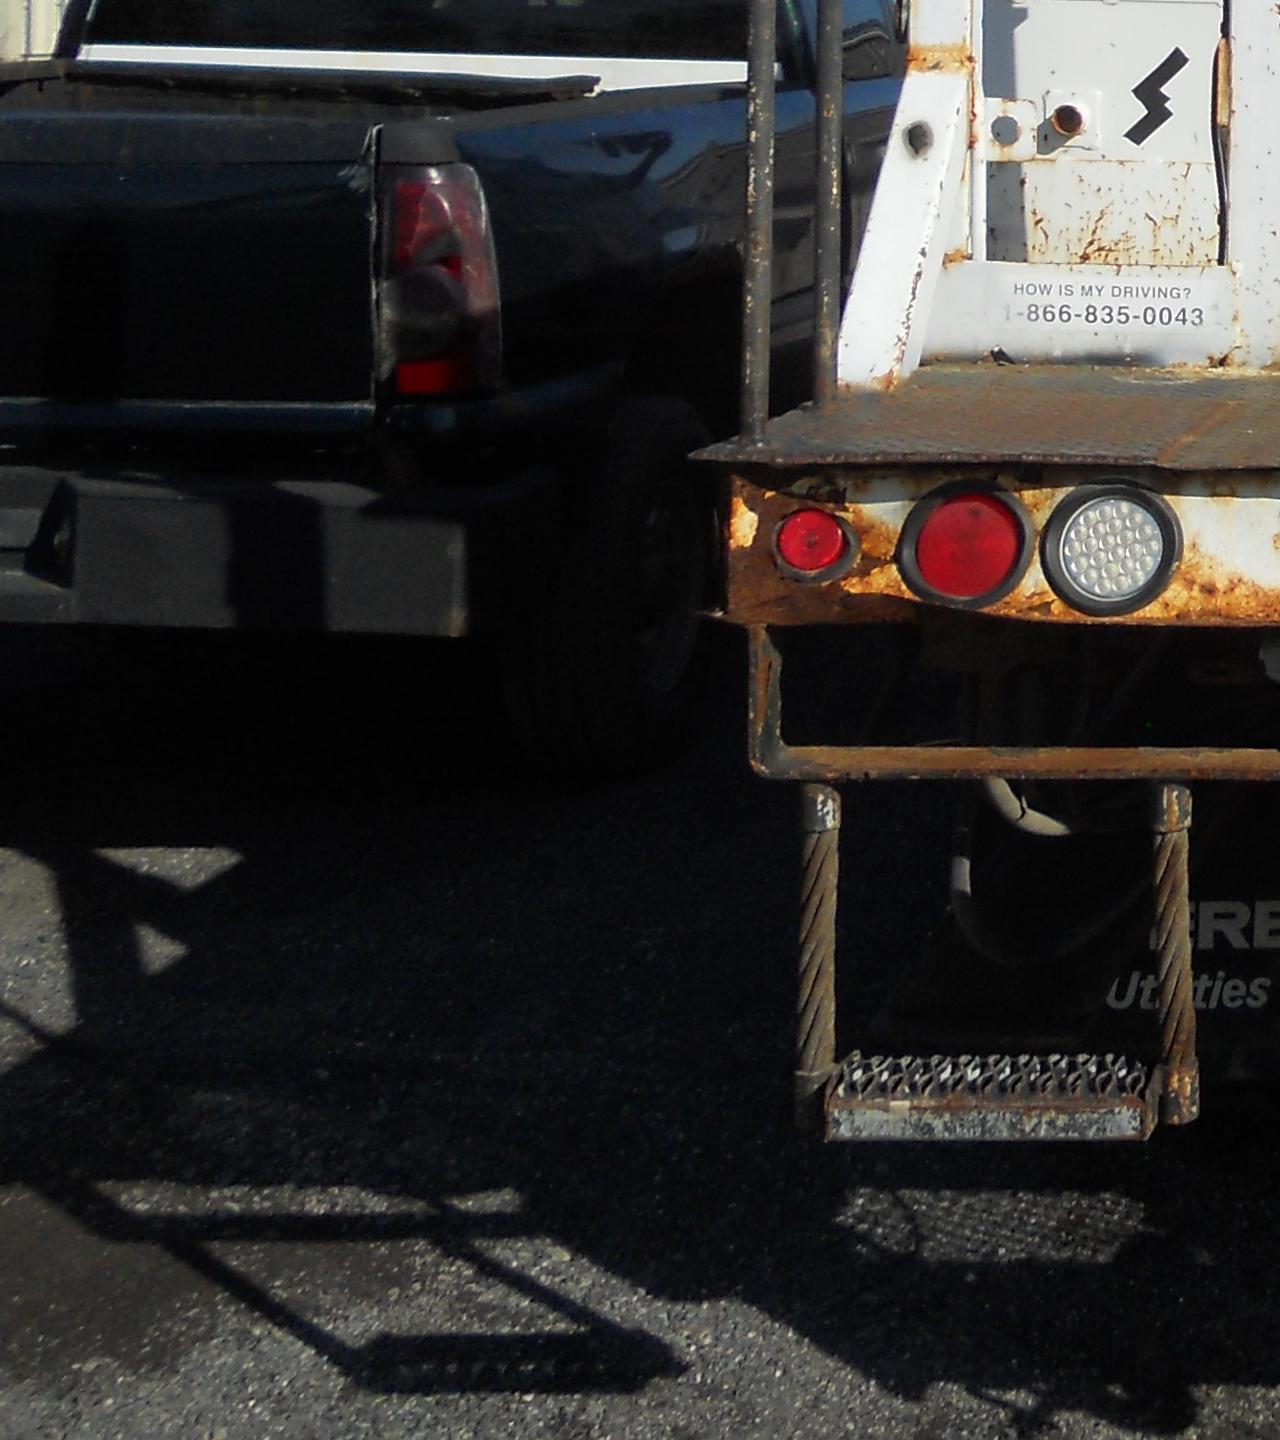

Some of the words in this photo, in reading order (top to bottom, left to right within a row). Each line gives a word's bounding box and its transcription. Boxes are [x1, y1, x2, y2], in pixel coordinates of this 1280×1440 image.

[1013, 283, 1053, 296] HOW
[1058, 284, 1074, 296] IS
[1080, 285, 1105, 297] MY
[1111, 285, 1192, 300] DRIVING?
[1003, 303, 1205, 327] 1-866-835-0043
[1105, 970, 1272, 1010] Utties
